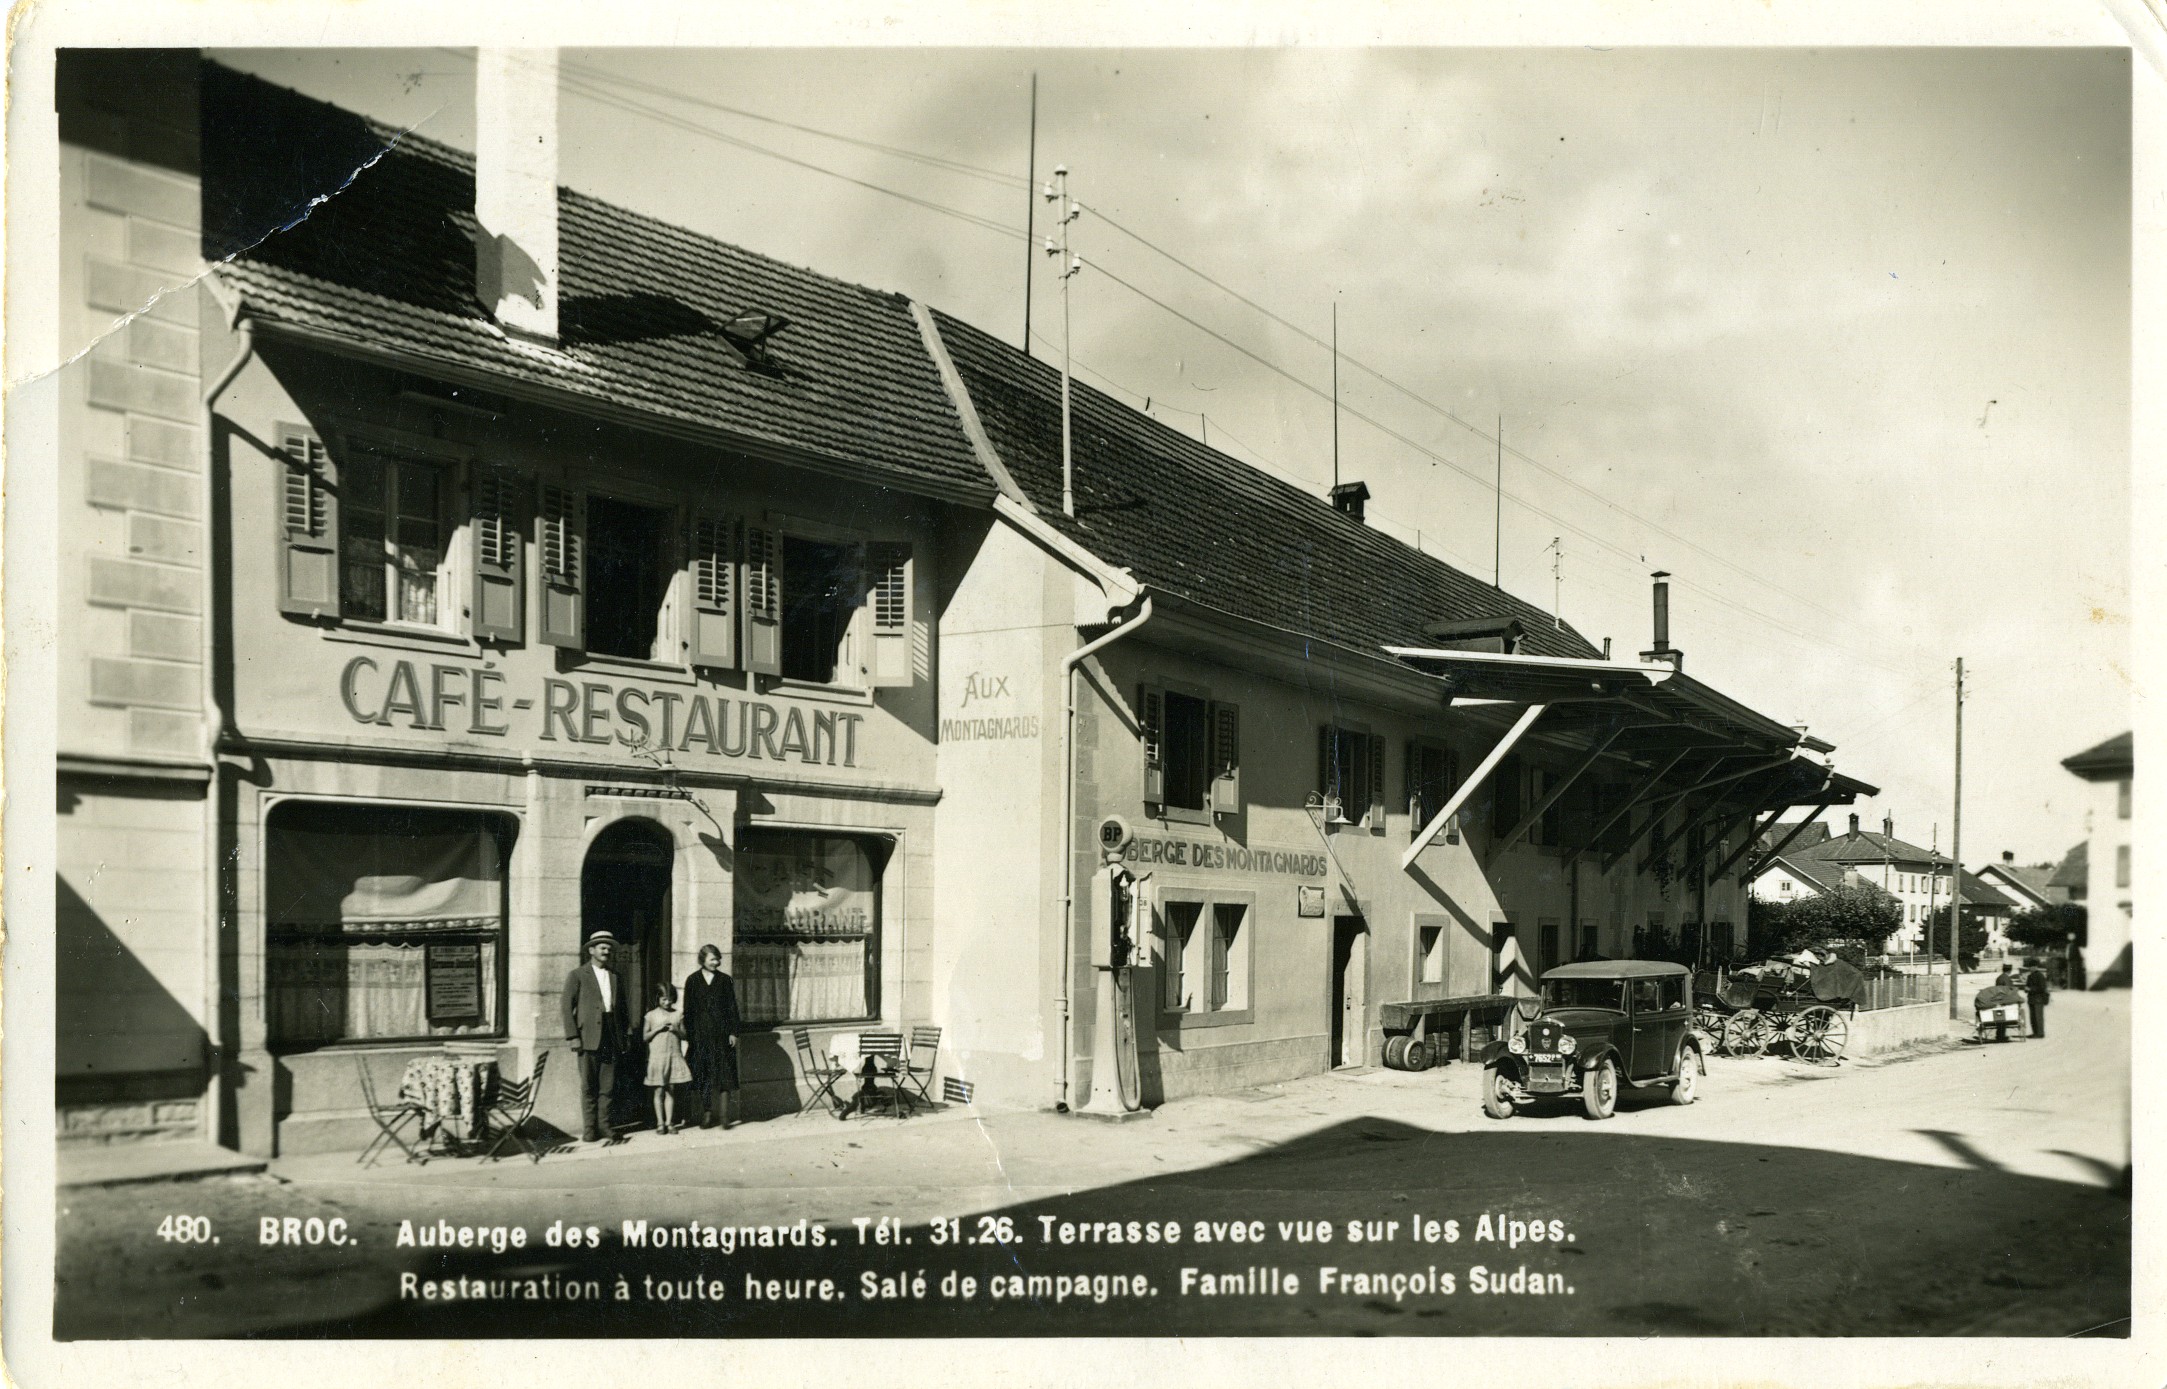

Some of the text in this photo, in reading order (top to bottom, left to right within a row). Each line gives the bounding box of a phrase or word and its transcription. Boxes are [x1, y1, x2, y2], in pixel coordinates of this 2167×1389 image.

[961, 671, 1010, 708] AUX
[340, 655, 864, 768] CAFÉ-RESTAURANT
[940, 716, 1039, 742] MONTAGNARDS
[1103, 826, 1122, 842] BP
[1101, 838, 1328, 877] BERGE DES MONTAGNARDS
